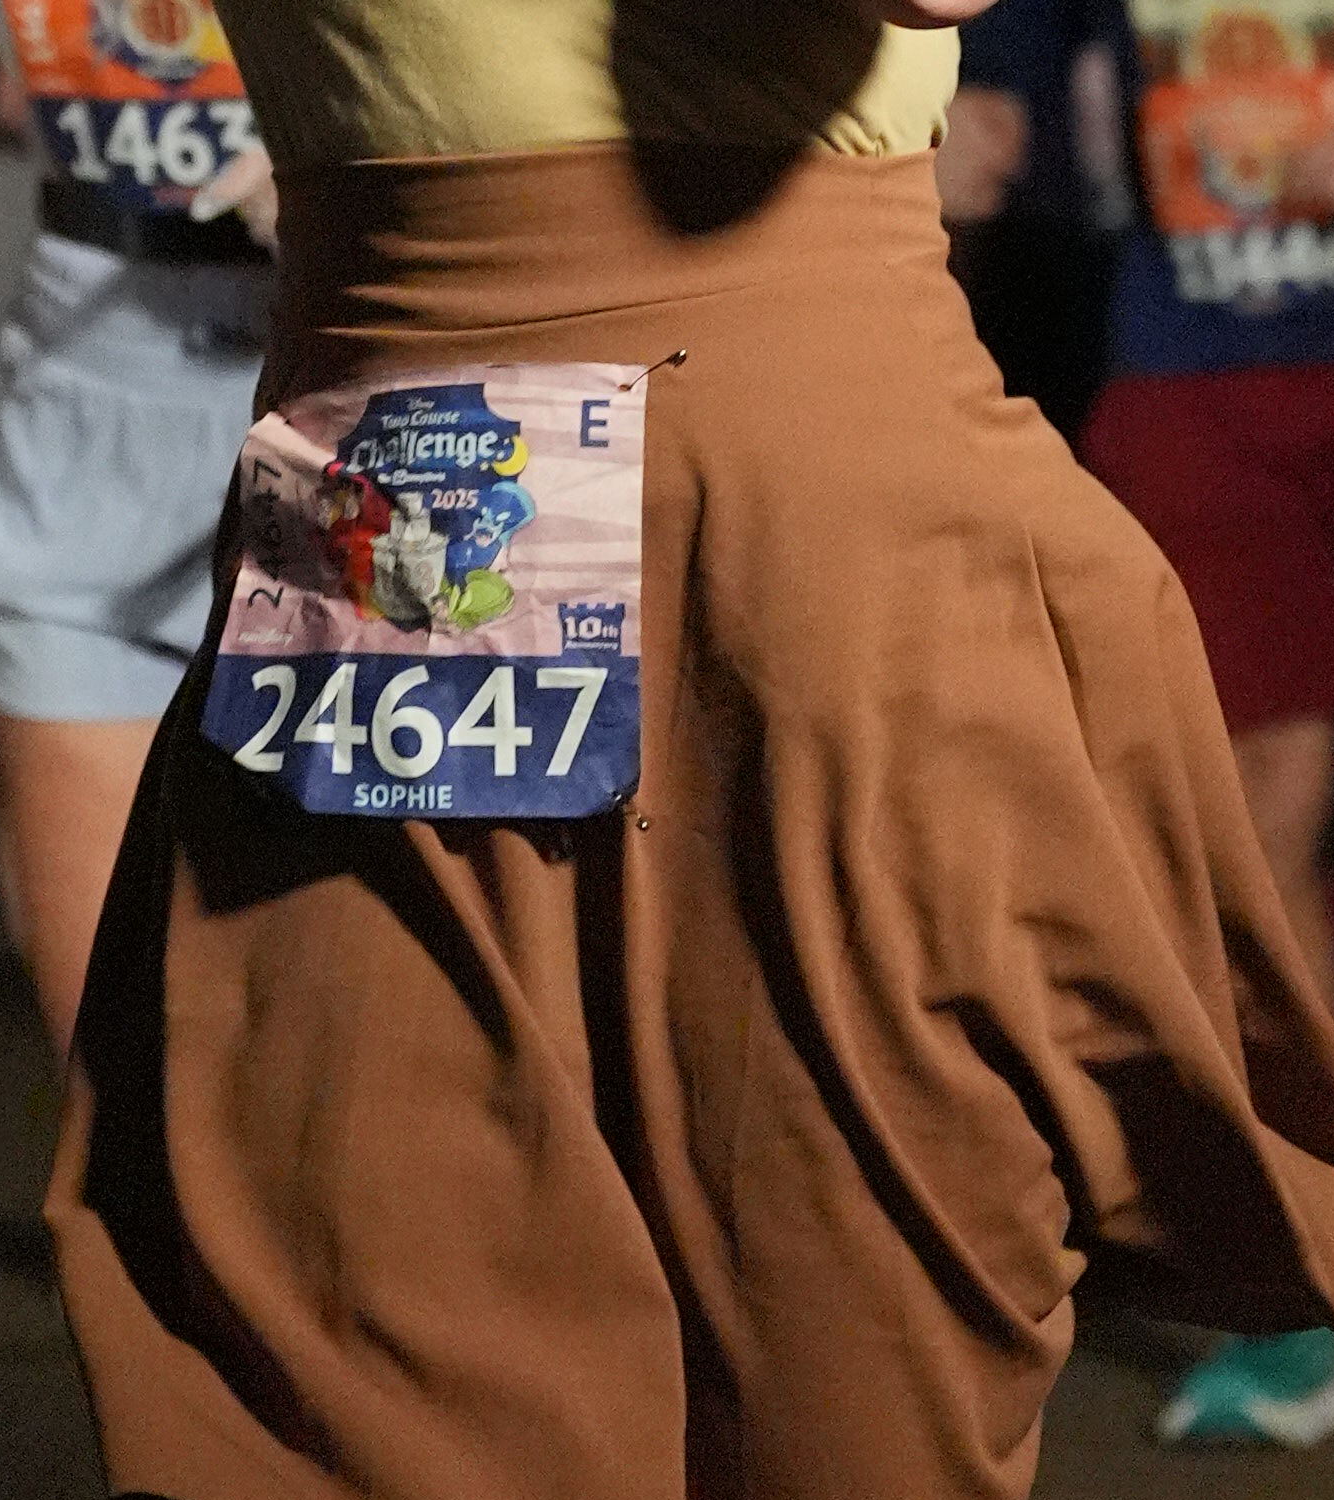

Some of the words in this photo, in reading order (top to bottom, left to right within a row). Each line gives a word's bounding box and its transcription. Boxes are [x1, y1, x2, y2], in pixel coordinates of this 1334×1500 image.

[411, 409, 461, 426] Course
[579, 399, 610, 448] E
[345, 429, 499, 474] Challenge
[430, 487, 481, 510] 2025
[233, 662, 609, 779] 24647
[353, 783, 453, 810] SOPHIE
